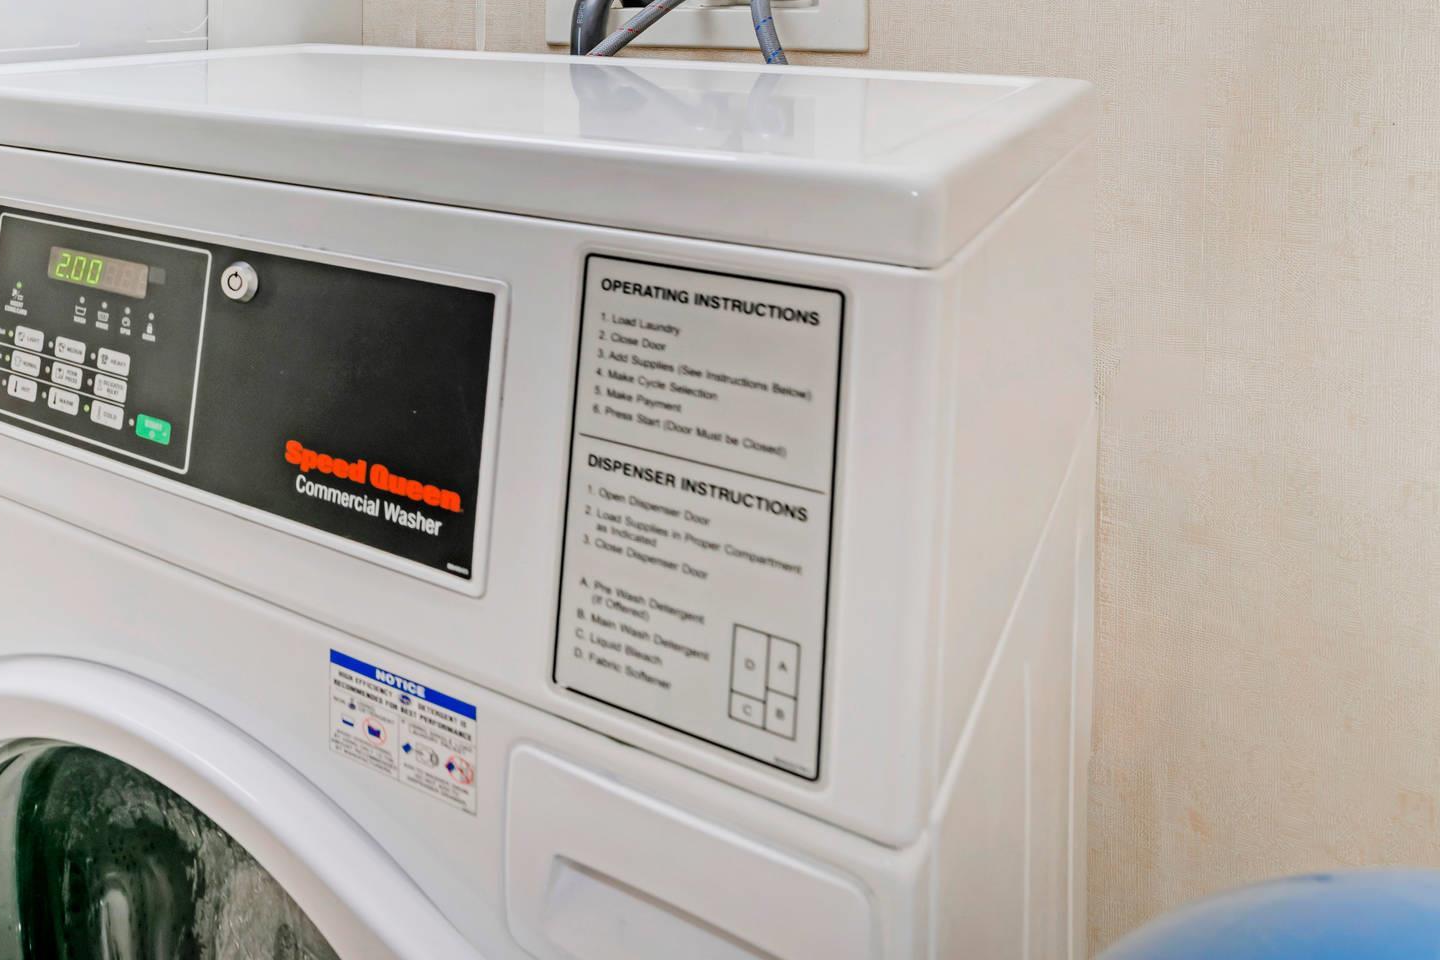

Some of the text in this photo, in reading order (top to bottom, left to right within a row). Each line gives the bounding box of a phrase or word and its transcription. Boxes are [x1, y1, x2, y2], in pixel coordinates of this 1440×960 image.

[601, 278, 820, 326] OPERATING INSTRUCTIONS
[611, 333, 639, 347] Close
[642, 337, 666, 351] Door
[612, 314, 636, 328] Load
[640, 318, 680, 337] Laundry
[608, 370, 635, 384] Make
[638, 374, 666, 391] Cycle
[670, 380, 718, 401] Selection
[609, 352, 628, 364] Add
[632, 355, 674, 375] Supplies
[707, 369, 768, 392] Instructions
[773, 382, 812, 403] Below)
[607, 388, 633, 403] Make
[636, 393, 682, 414] Payment
[605, 407, 632, 421] Press
[637, 413, 660, 428] Start
[664, 418, 692, 436] (Door
[697, 426, 722, 442] Must
[725, 433, 738, 446] be
[743, 436, 788, 458] Closed)
[285, 440, 461, 513] Speed Queen
[588, 454, 808, 523] DISPENSER INSTRUCTIONS
[296, 474, 443, 536] Commercial Washer
[598, 488, 625, 506] Open
[629, 494, 680, 518] Dispenser
[685, 509, 710, 526] Door
[597, 508, 622, 524] Load
[625, 516, 668, 538] Supplies
[672, 528, 681, 540] in
[685, 531, 720, 552] Proper
[725, 543, 802, 575] Compartment
[611, 525, 658, 548] Indicated
[595, 537, 623, 553] Close
[627, 545, 678, 570] Dispenser
[682, 563, 708, 579] Door
[594, 580, 612, 594] Pre
[616, 586, 645, 605] Wash
[649, 596, 704, 625] Detergent
[590, 613, 616, 630] Main
[620, 621, 650, 641] Wash
[654, 632, 709, 661] Detergent
[590, 632, 621, 652] Liquid
[625, 641, 662, 666] Bleach
[376, 668, 426, 698] NOTICE
[589, 652, 621, 670] Fabric
[625, 661, 671, 690] Softener
[420, 714, 472, 741] PERFORMANCE
